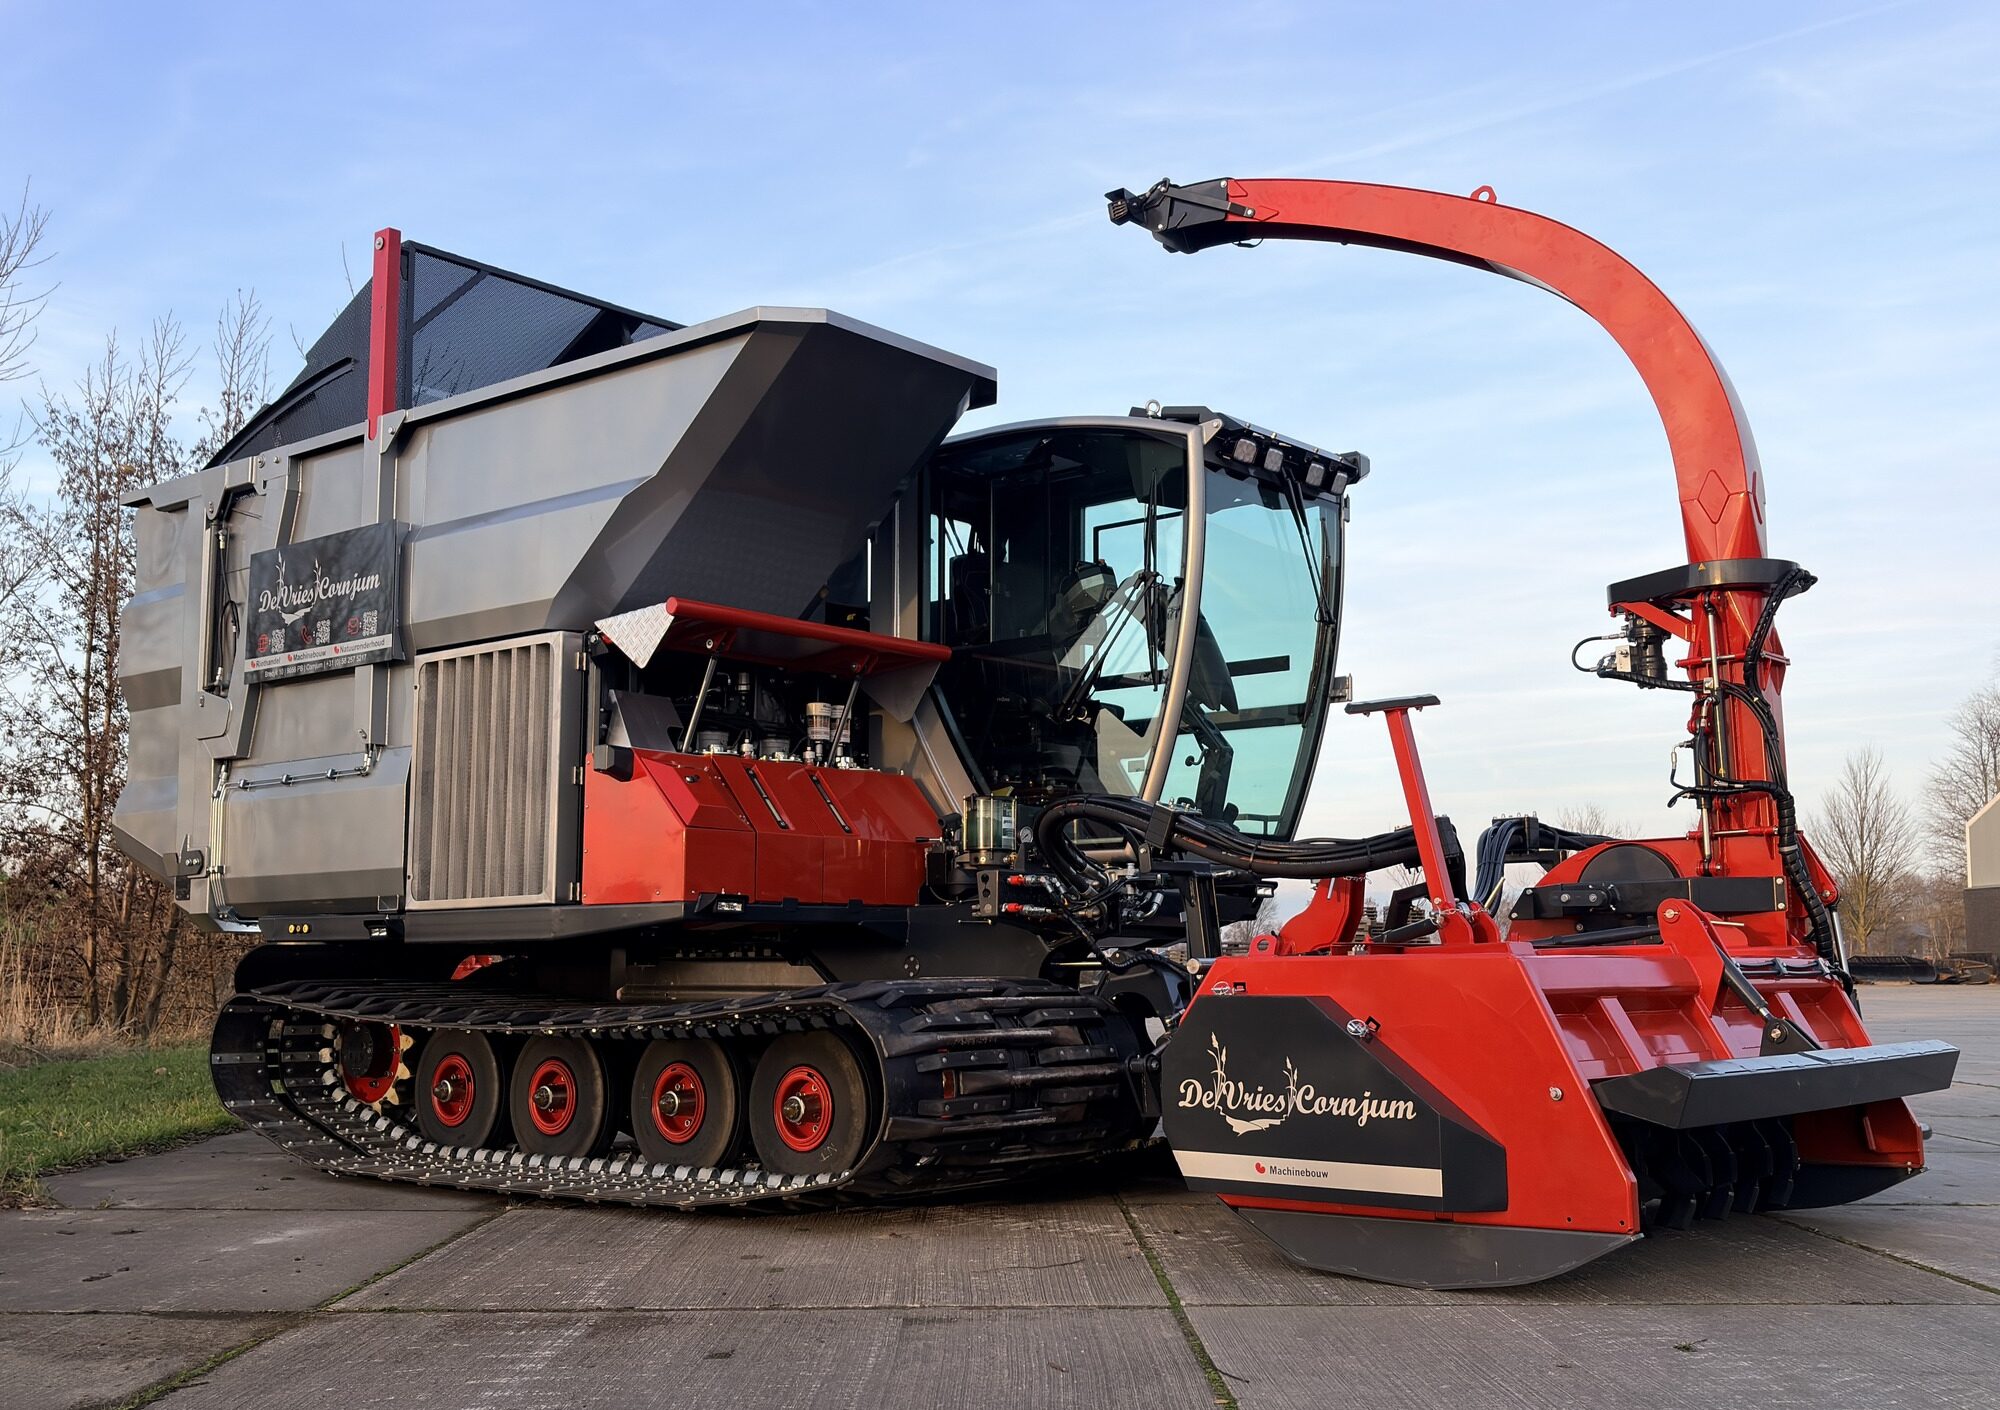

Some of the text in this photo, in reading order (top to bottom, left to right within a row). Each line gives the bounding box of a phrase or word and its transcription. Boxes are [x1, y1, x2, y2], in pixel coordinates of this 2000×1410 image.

[258, 573, 380, 613] De Vries Cornjum
[294, 649, 326, 661] Machinebouw
[340, 639, 385, 653] Natuuronderhoud
[1178, 1079, 1417, 1127] De Vries Cornjum
[1269, 1165, 1329, 1179] Machinebouw
